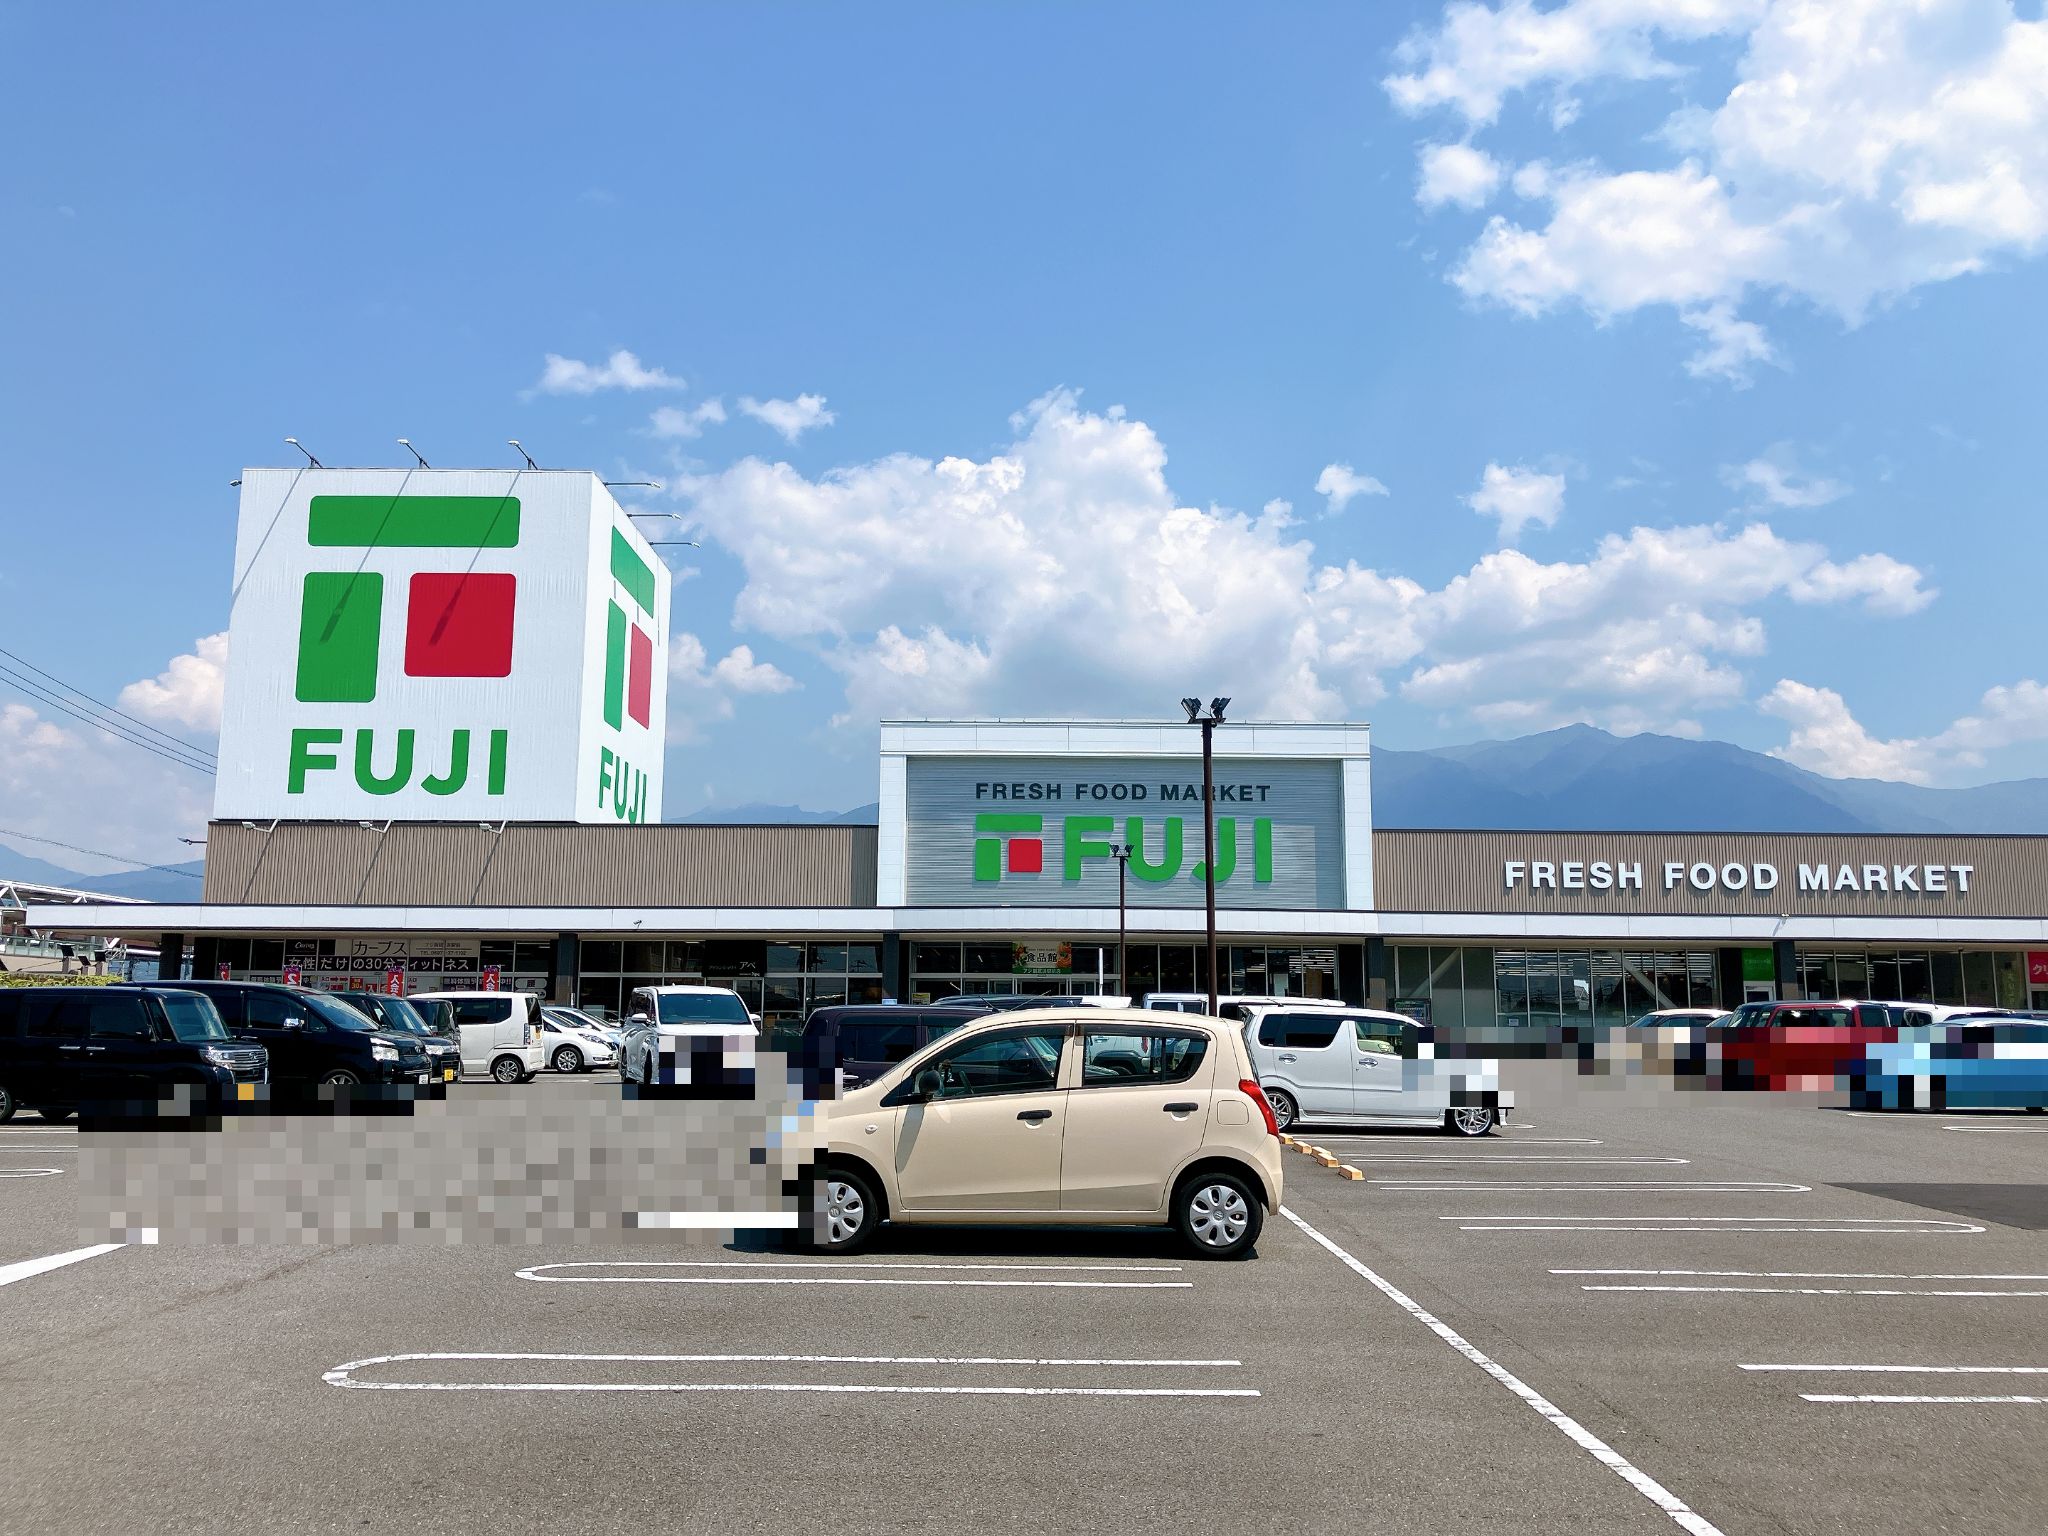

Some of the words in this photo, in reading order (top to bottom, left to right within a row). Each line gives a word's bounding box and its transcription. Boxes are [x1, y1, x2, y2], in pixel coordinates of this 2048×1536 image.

[288, 729, 507, 795] FUJI
[599, 746, 647, 824] FUJI
[976, 783, 1061, 800] FRESH
[1075, 784, 1148, 801] FOOD
[1064, 816, 1272, 883] FUJI
[1505, 861, 1643, 889] FRESH
[1664, 862, 1779, 890] FOOD
[1799, 863, 1974, 892] MARKET
[1027, 953, 1057, 962] 食品館
